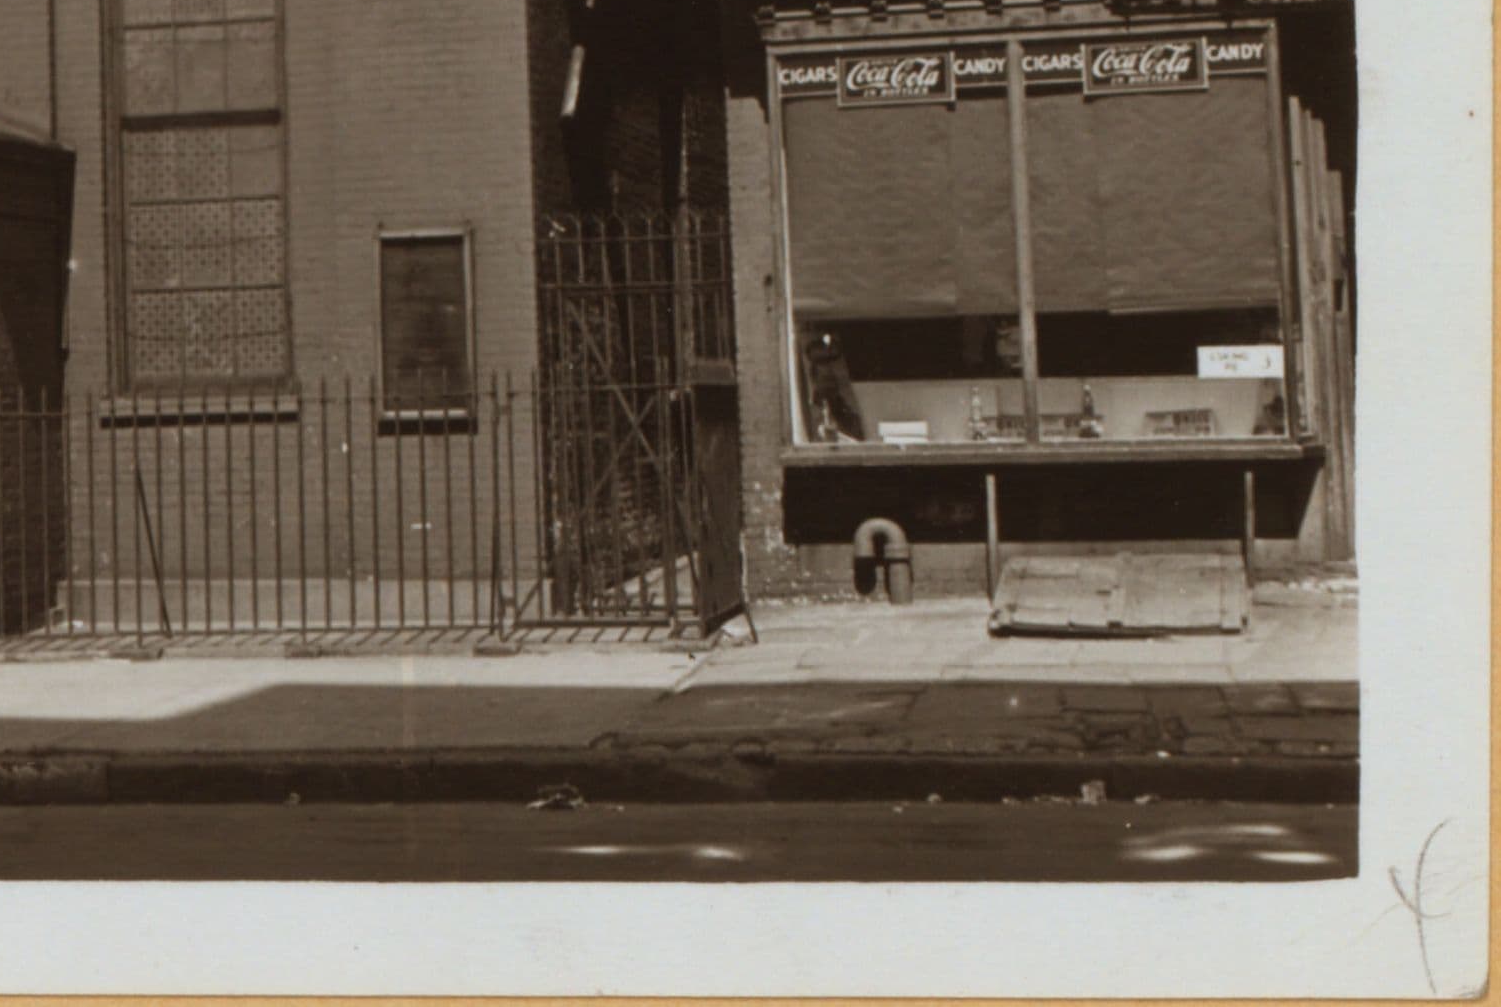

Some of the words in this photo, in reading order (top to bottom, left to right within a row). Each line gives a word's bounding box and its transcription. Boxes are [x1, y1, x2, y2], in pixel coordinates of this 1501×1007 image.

[1206, 42, 1264, 62] CANDY
[953, 57, 1007, 76] CANDY
[1021, 53, 1084, 72] CIGARS
[779, 66, 838, 86] CIGARS
